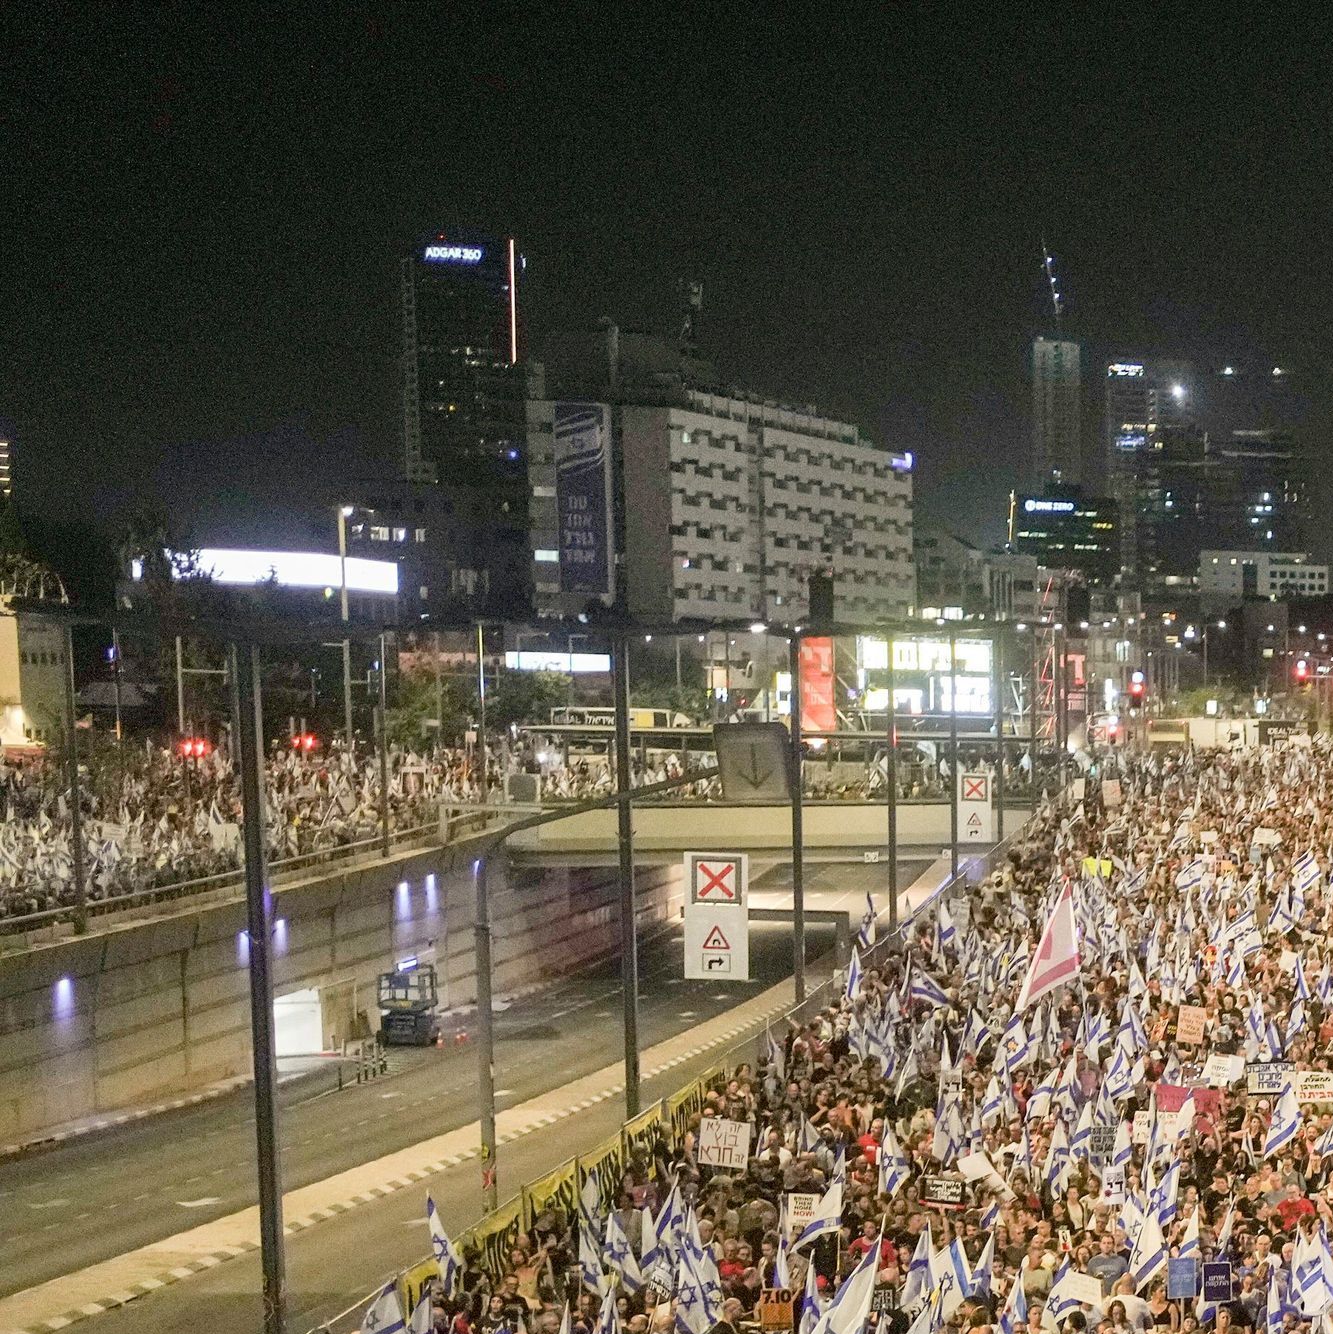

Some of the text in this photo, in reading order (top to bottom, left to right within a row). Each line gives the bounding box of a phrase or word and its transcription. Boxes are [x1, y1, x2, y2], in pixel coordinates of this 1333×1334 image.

[425, 246, 482, 261] ADGAR 360
[707, 1118, 742, 1132] זה לא
[715, 1132, 739, 1147] בוץ
[700, 1146, 746, 1164] זה חרא
[763, 1290, 792, 1305] 7.10
